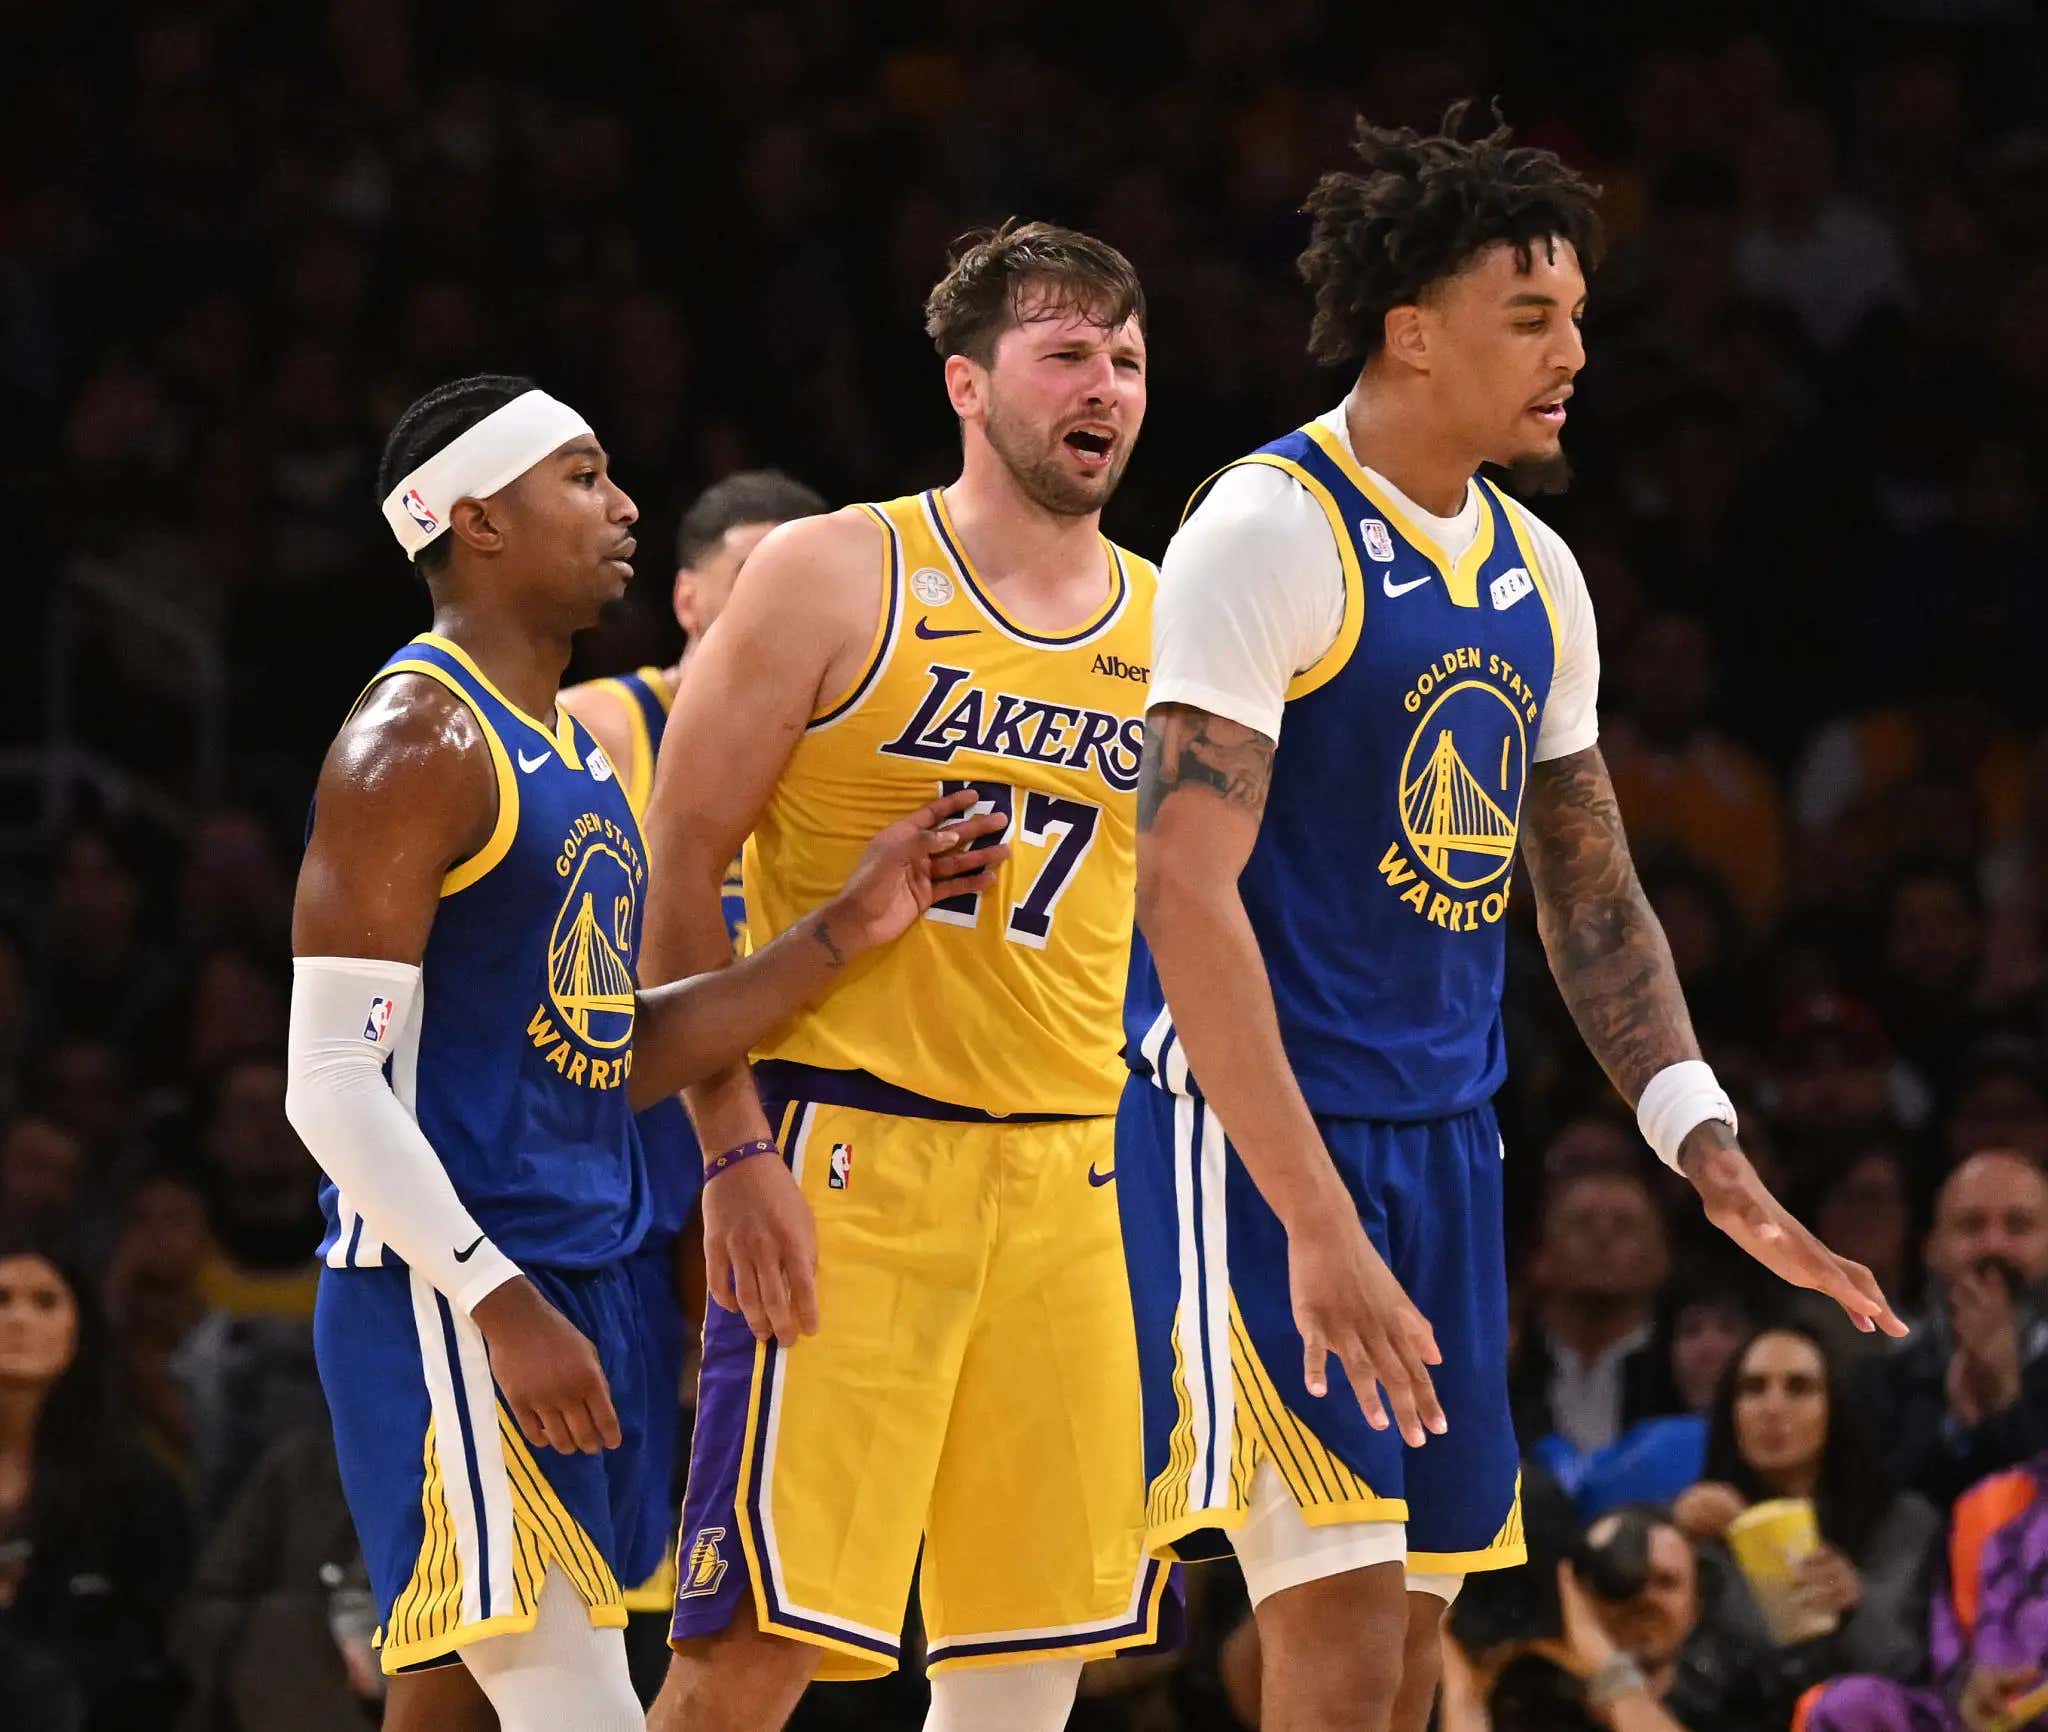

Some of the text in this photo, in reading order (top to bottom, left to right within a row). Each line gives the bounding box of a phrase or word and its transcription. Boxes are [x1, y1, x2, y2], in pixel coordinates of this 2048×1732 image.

[1404, 647, 1538, 724] GOLDEN STATE
[879, 664, 1145, 792] LAKERS
[1500, 735, 1511, 791] 1
[556, 812, 643, 885] GOLDEN STATE
[614, 895, 630, 951] 12
